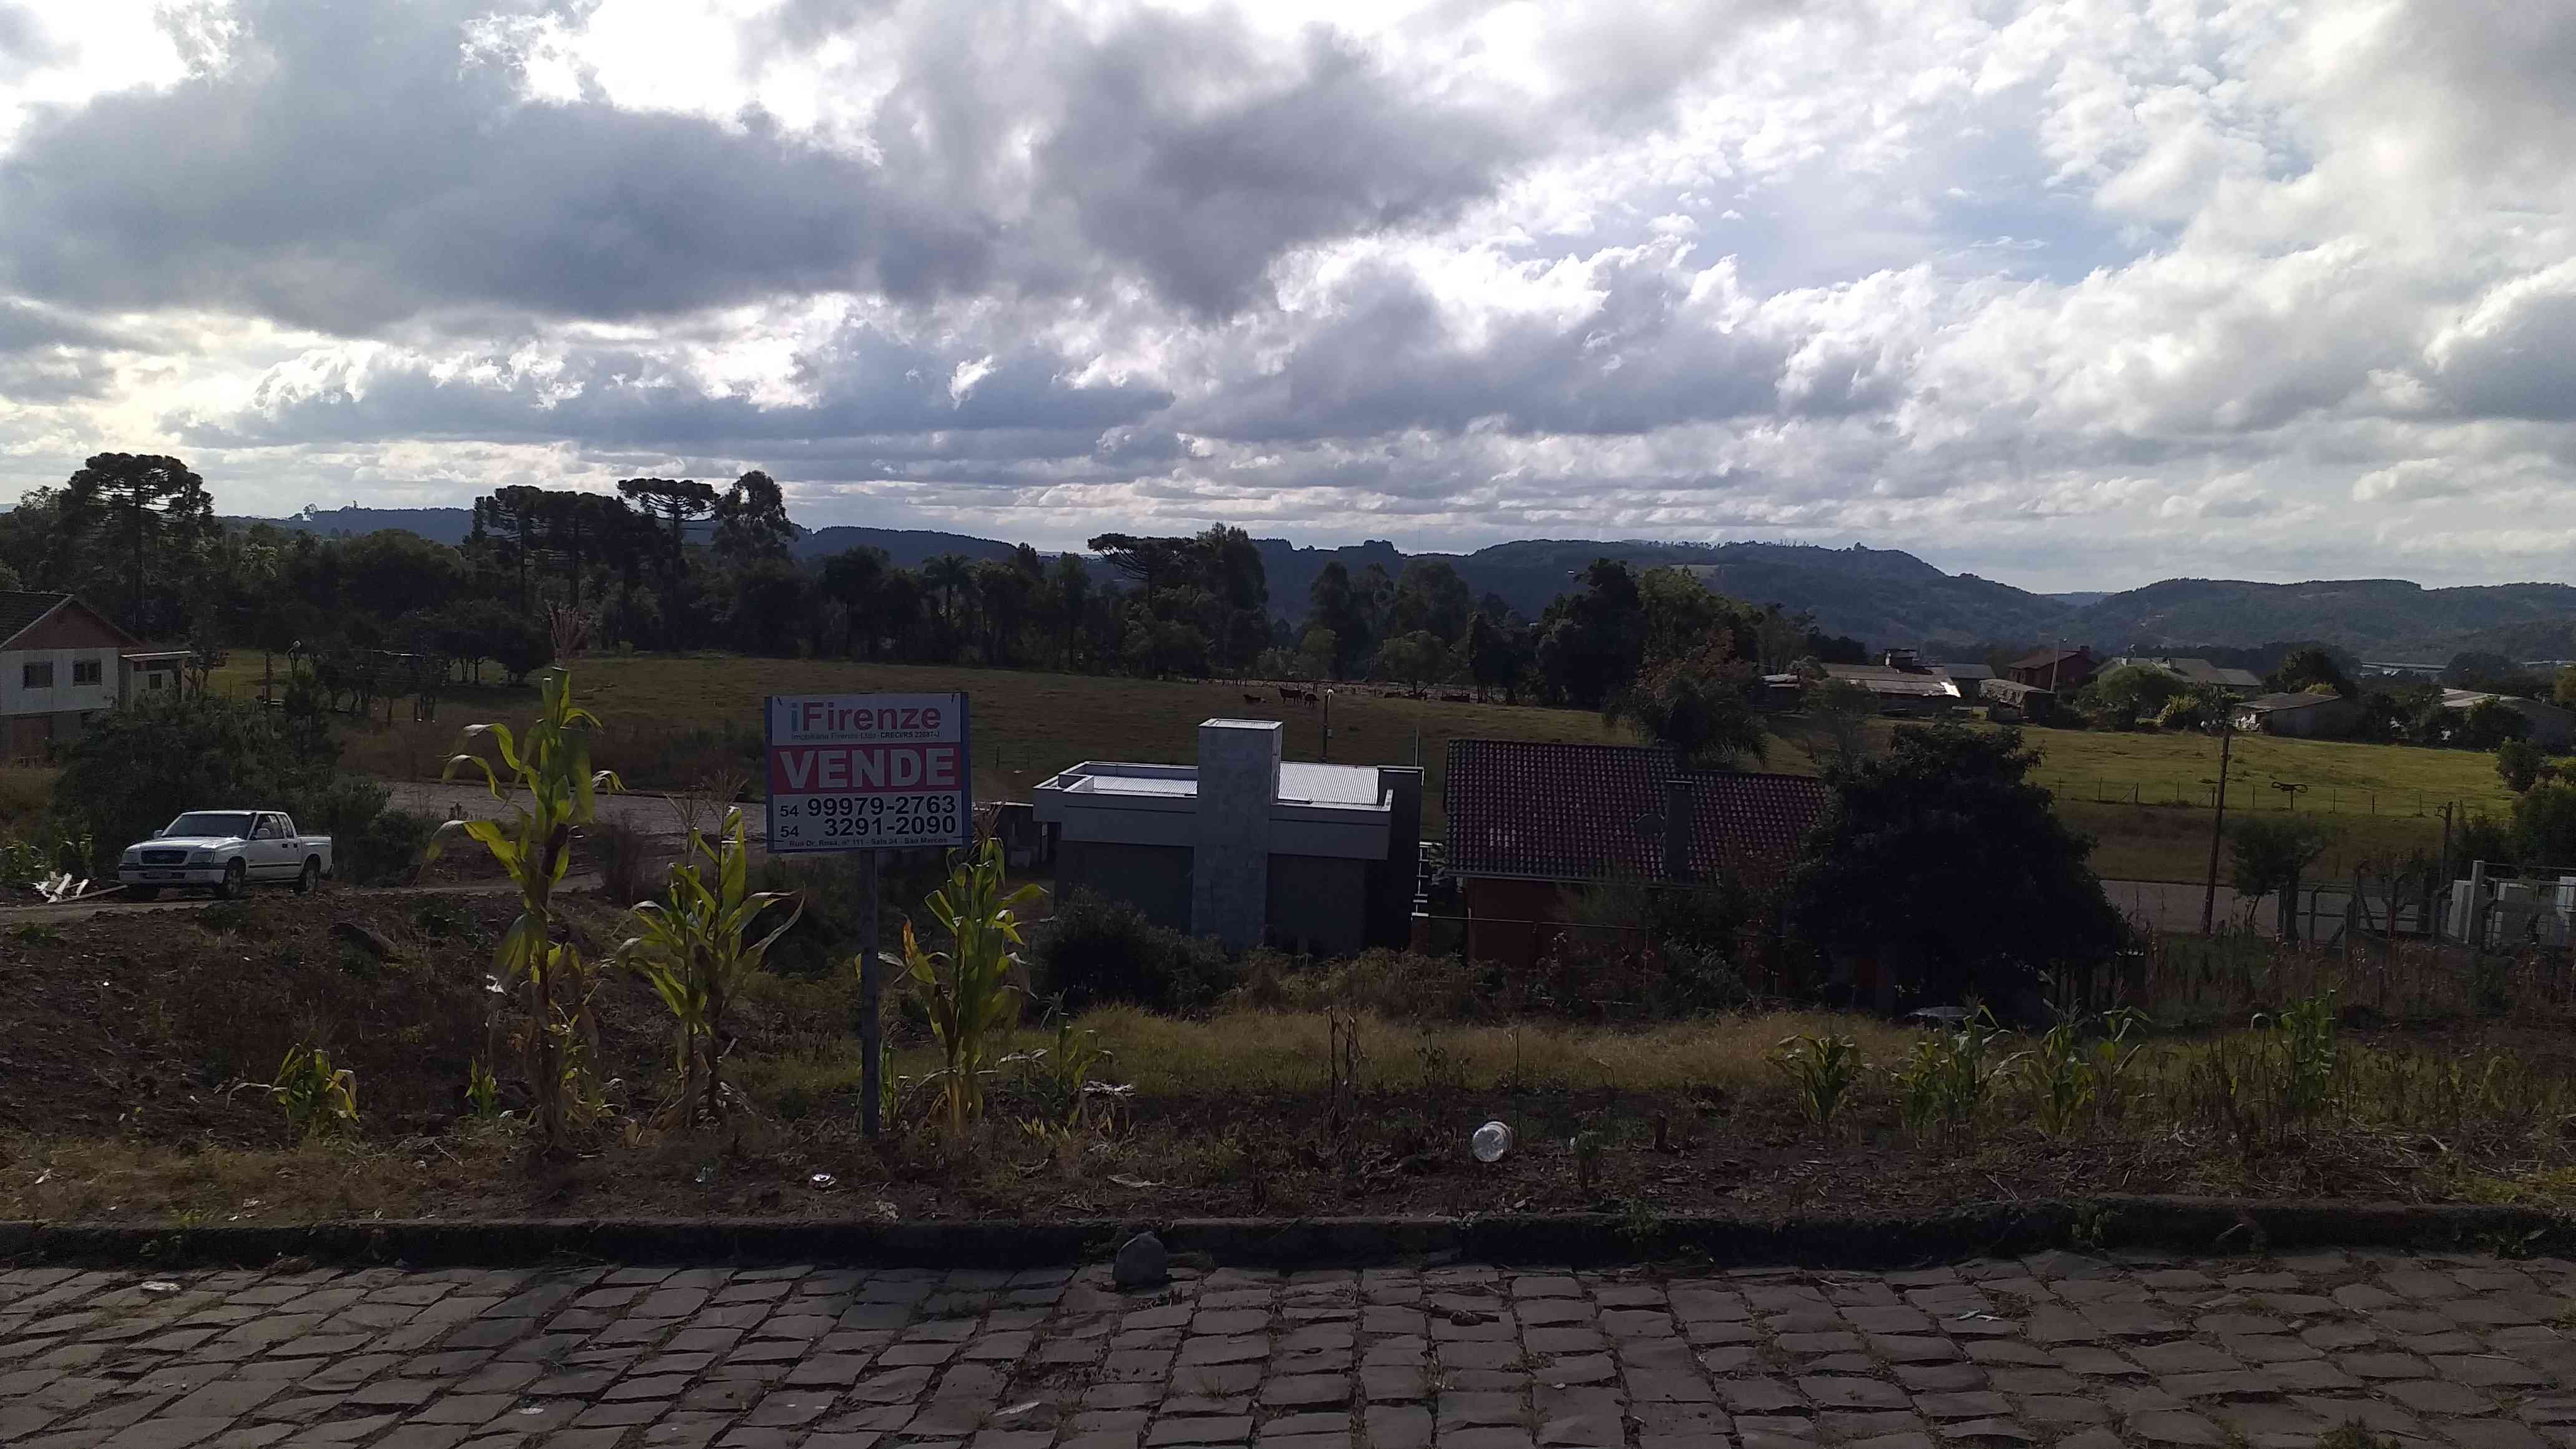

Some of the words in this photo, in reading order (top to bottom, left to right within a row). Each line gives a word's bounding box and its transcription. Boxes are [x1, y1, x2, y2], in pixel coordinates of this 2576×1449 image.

[791, 701, 941, 731] iFirenze
[779, 748, 955, 789] VENDE
[780, 806, 799, 817] 54
[807, 795, 956, 817] 99979-2763
[780, 826, 799, 837] 54
[824, 816, 956, 837] 3291-2090
